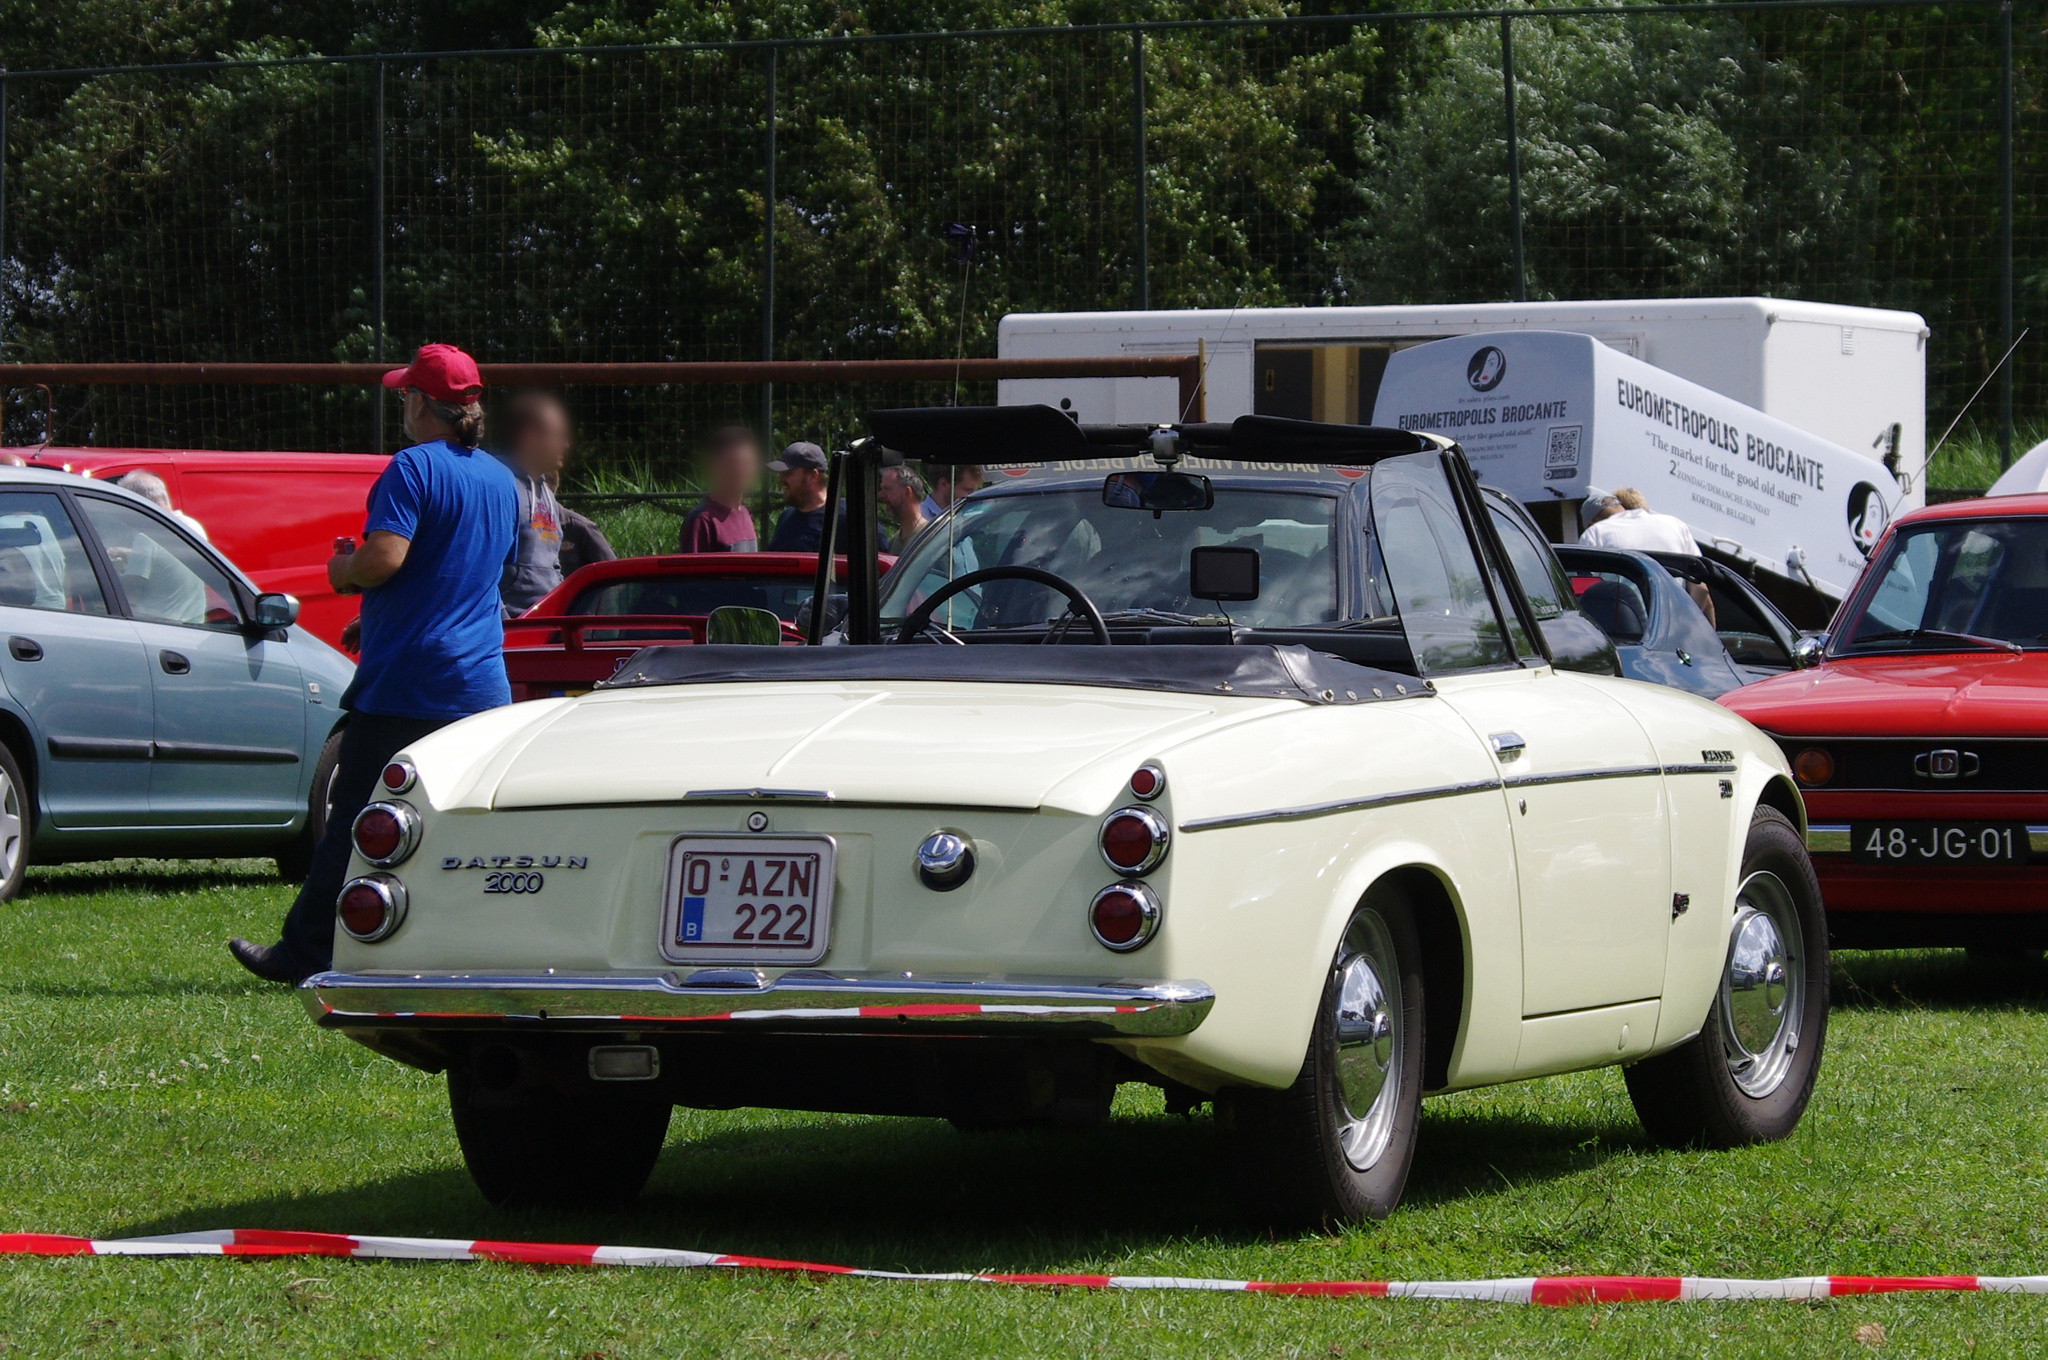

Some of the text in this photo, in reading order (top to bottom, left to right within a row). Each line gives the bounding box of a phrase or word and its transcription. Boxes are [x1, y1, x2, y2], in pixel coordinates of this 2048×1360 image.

[1398, 400, 1567, 430] EUROMETROPOLIS BROCANTE
[1467, 432, 1476, 440] for
[1477, 431, 1488, 440] the
[1488, 430, 1505, 440] good
[1505, 429, 1517, 437] old
[1617, 377, 1824, 491] EUROMETROPOLIS BROCANTE
[1670, 445, 1704, 467] market
[1705, 455, 1719, 473] for
[1720, 463, 1736, 480] the
[1736, 473, 1760, 490] good
[1761, 481, 1775, 497] old
[1726, 506, 1756, 526] BELGIUM
[1937, 757, 1953, 771] D
[1865, 827, 2013, 859] 48-JG-01
[441, 855, 588, 870] DATSUN
[483, 872, 544, 894] 2000
[686, 922, 697, 937] B
[733, 903, 807, 941] 222
